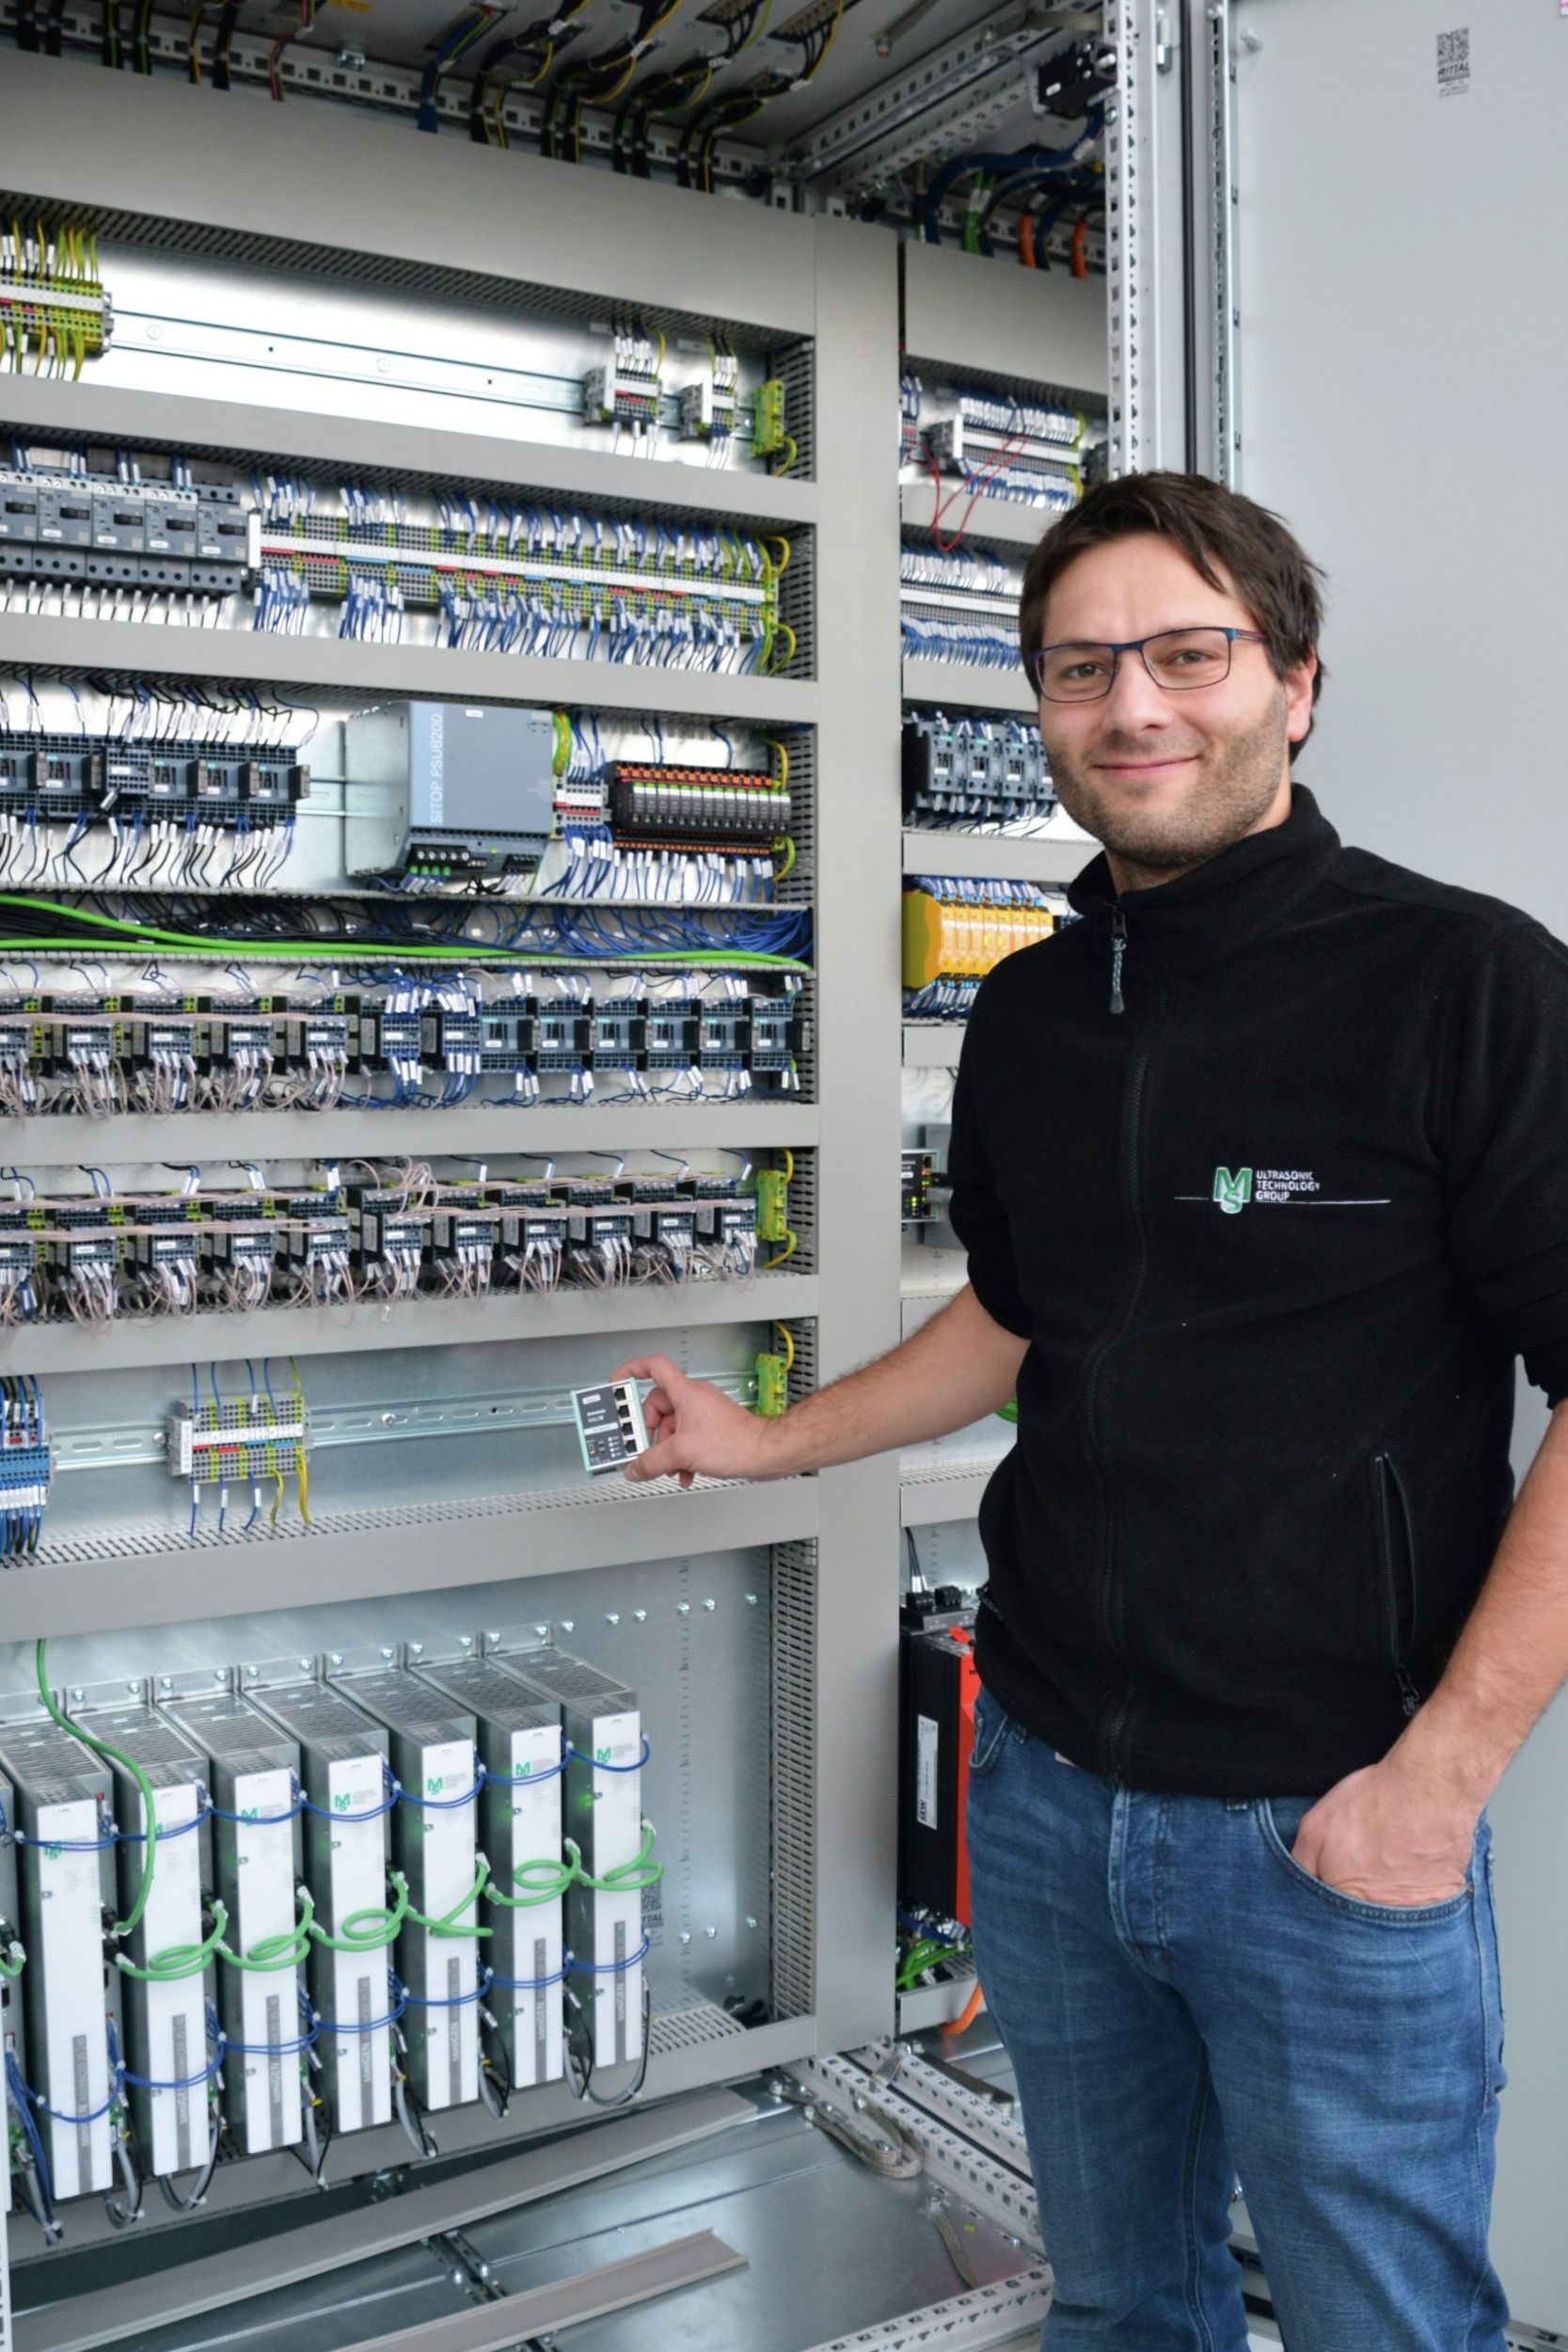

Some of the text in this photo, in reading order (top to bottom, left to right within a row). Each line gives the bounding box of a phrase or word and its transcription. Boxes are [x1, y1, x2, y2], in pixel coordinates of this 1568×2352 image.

[1437, 61, 1470, 76] RITTAL
[430, 715, 444, 823] SITOP PSU8200
[1256, 1169, 1314, 1181] ULTRASONIC
[1256, 1180, 1321, 1191] TECHNOLOGY
[1256, 1190, 1291, 1201] GROUP
